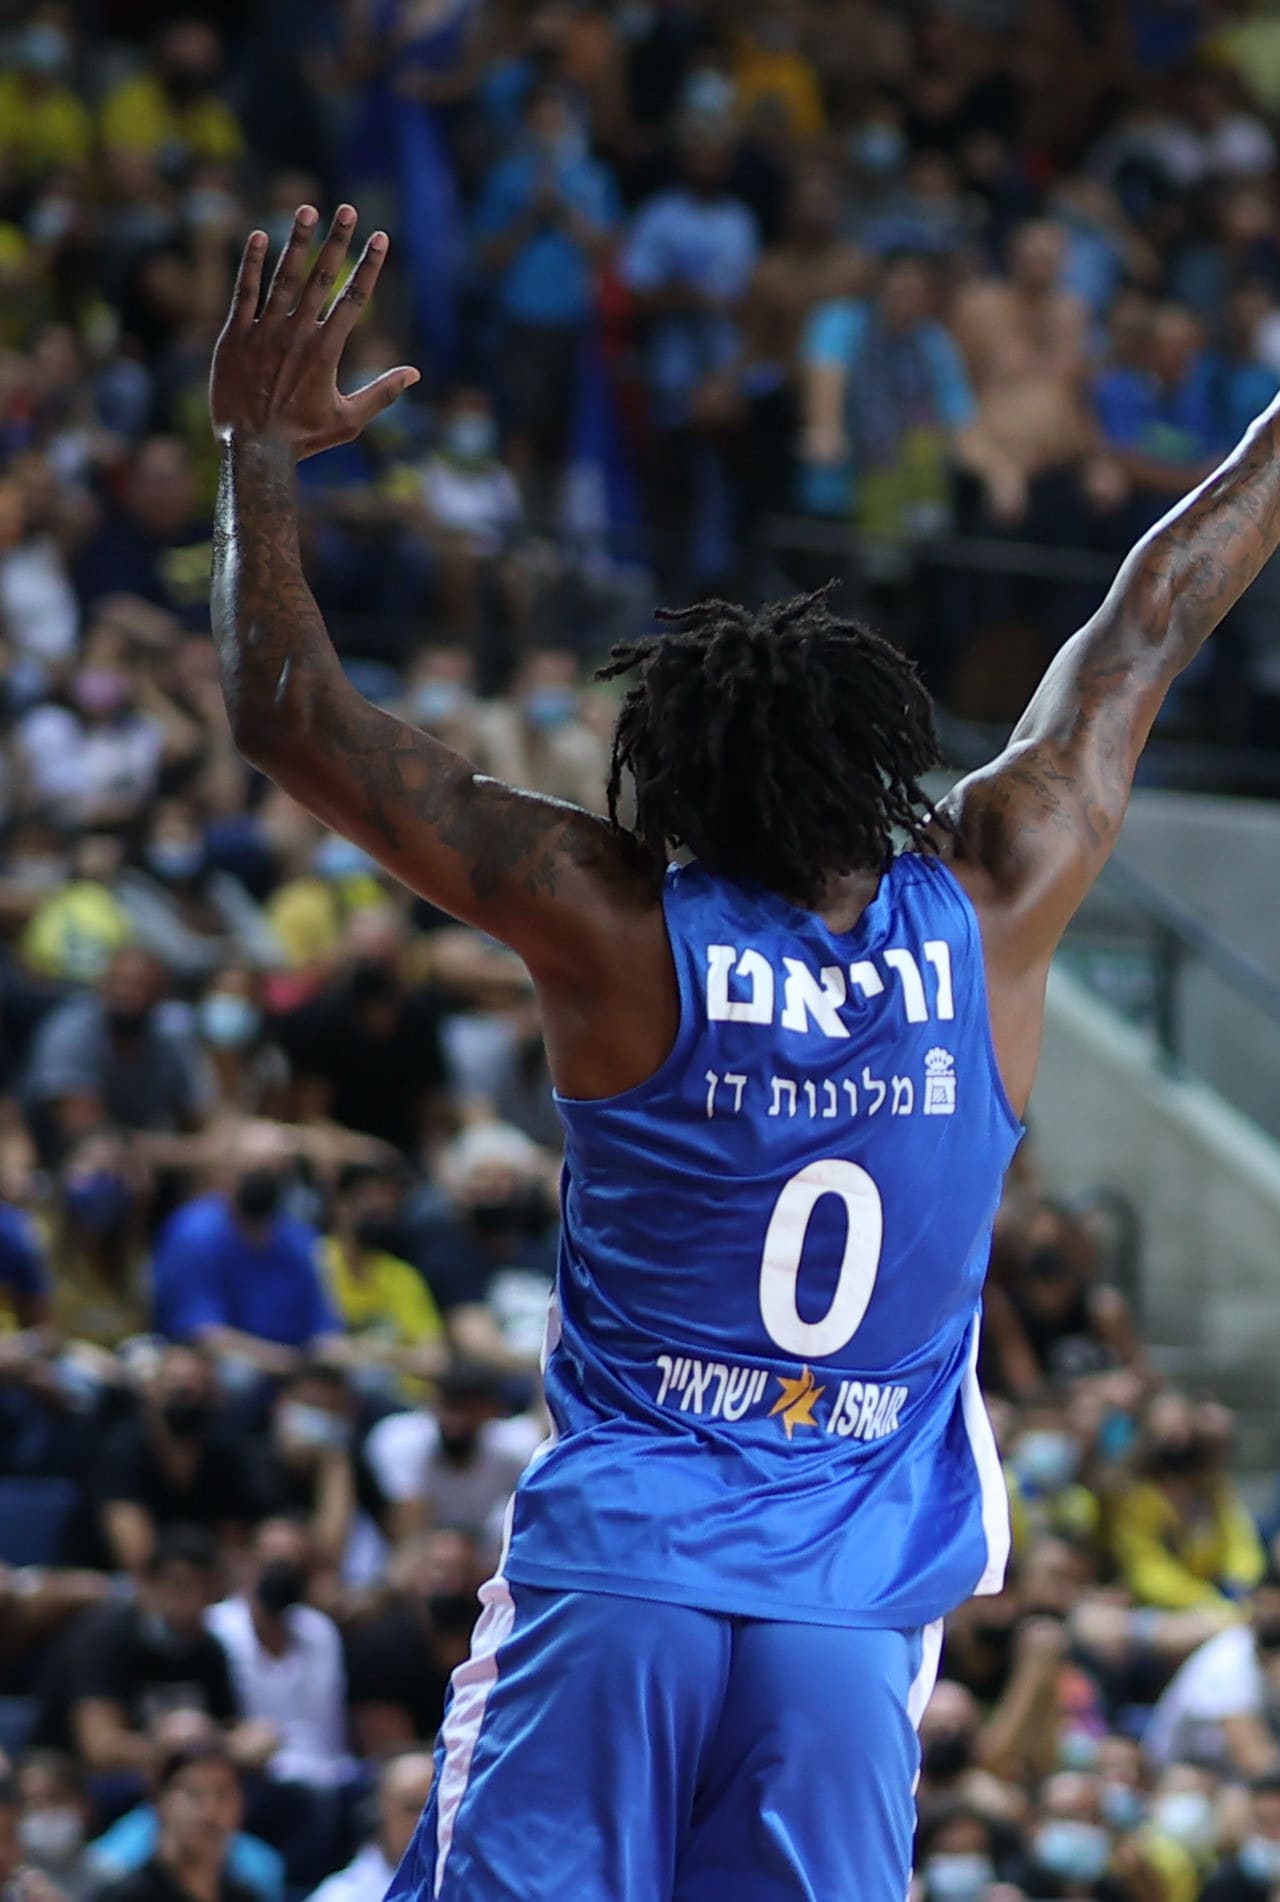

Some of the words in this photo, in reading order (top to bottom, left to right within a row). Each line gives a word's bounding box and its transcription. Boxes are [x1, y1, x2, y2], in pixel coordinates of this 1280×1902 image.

[706, 940, 954, 1039] וויאט
[705, 1069, 748, 1120] דן
[767, 1066, 914, 1119] מלונות
[759, 1158, 883, 1358] 0
[656, 1354, 768, 1422] ישראייר
[826, 1380, 909, 1441] ISRAIR
